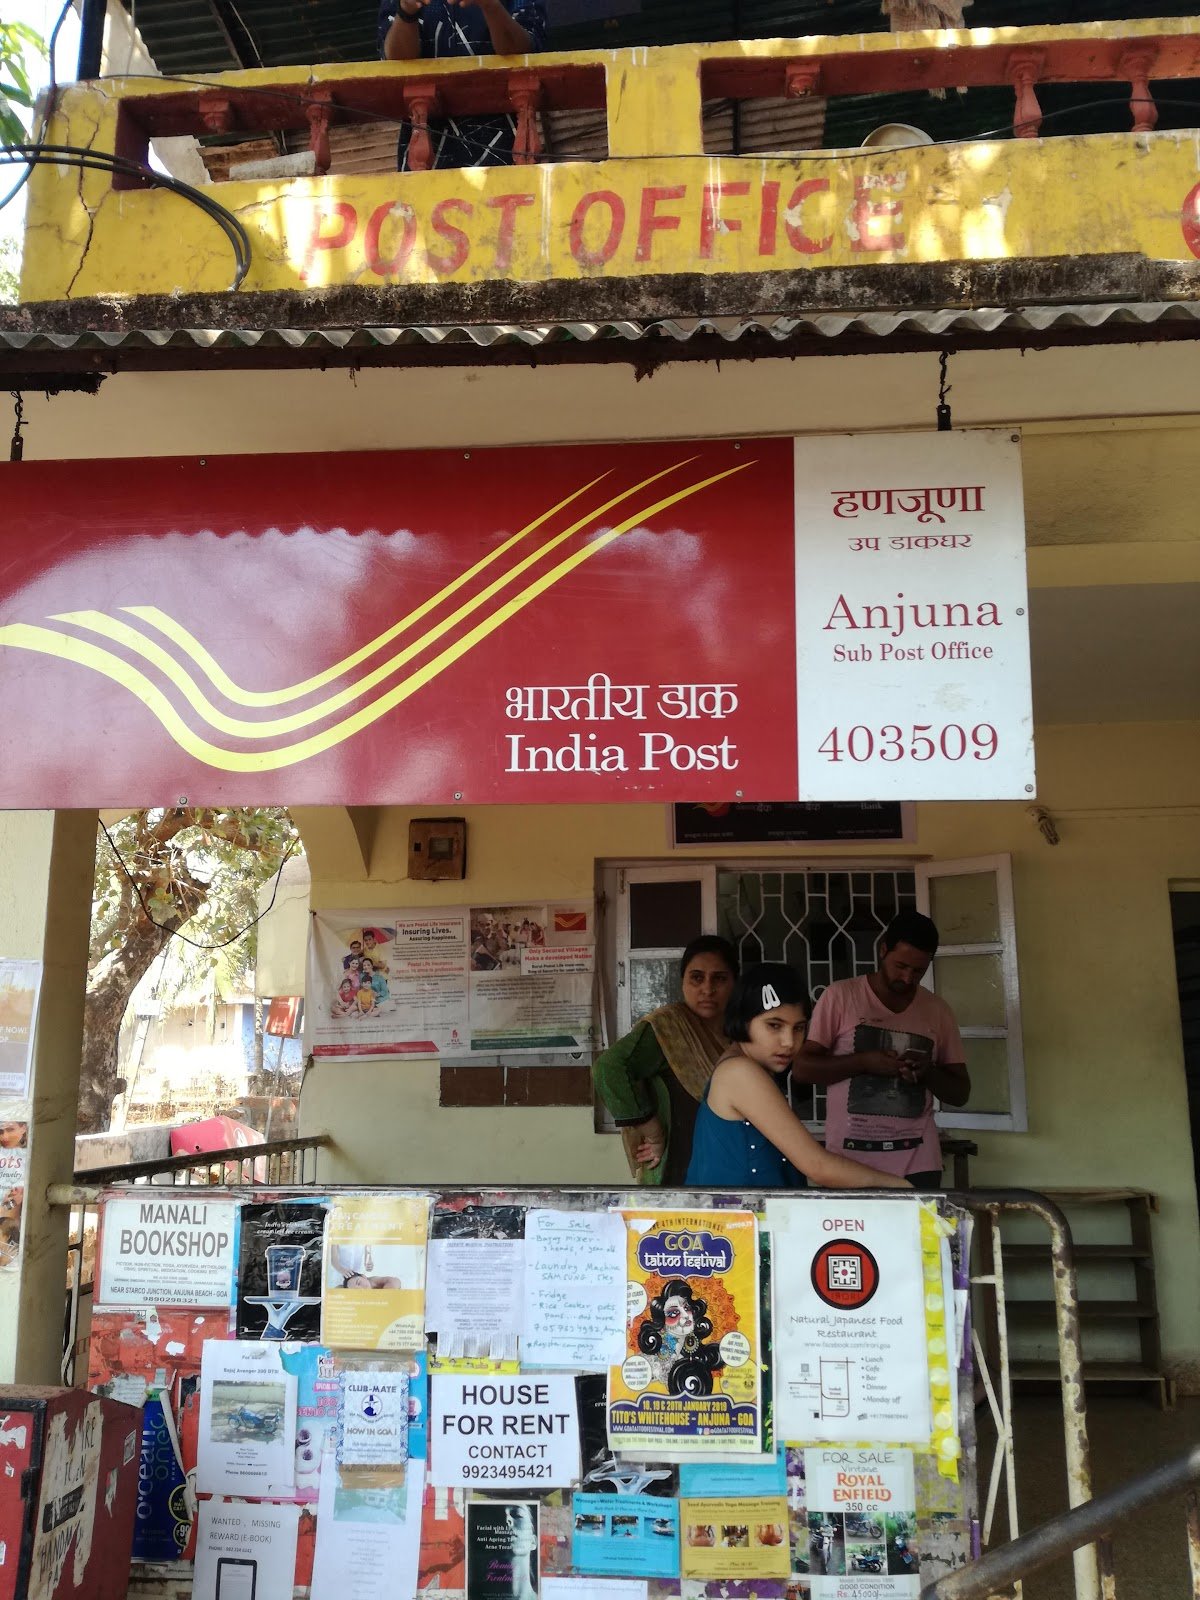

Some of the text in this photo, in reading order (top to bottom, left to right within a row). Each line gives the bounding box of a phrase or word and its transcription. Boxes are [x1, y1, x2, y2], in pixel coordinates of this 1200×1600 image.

[300, 175, 906, 280] POST OFFICE
[831, 486, 986, 523] हणजूणा
[848, 534, 973, 551] उप डाकघर
[822, 592, 1003, 637] Anjuna
[833, 641, 993, 662] Sub Post Office
[505, 673, 739, 721] भारतीय डाक
[818, 723, 998, 762] 403509
[505, 732, 739, 772] India Post
[402, 928, 430, 936] Insuring
[140, 1204, 207, 1225] MANALI
[536, 1215, 555, 1228] For
[675, 1218, 724, 1233] INTERNATIONAL
[822, 1219, 865, 1232] OPEN
[120, 1229, 229, 1257] BOOKSHOP
[566, 1235, 593, 1243] mixer
[665, 1234, 705, 1251] GOA
[535, 1258, 577, 1274] Laundry
[644, 1250, 727, 1270] tattoo festival
[539, 1289, 568, 1302] Fridge
[790, 1315, 903, 1327] Natural Japanese Food
[817, 1330, 877, 1338] Restaurant
[348, 1385, 397, 1393] CLUB-MATE
[462, 1384, 549, 1405] HOUSE
[667, 1401, 682, 1410] 20TH
[683, 1401, 711, 1411] JANUARY
[712, 1402, 727, 1411] 2019
[866, 1396, 890, 1405] Monday
[442, 1414, 570, 1435] FOR RENT
[612, 1411, 754, 1427] TITO'S WHITEHOUSE ANJUNA GOA
[346, 1427, 365, 1435] NOW
[468, 1445, 548, 1459] CONTACT
[823, 1452, 896, 1464] FOR SALE
[462, 1464, 553, 1478] 9923495421
[841, 1465, 878, 1473] Vintage
[837, 1472, 885, 1488] ROYAL
[833, 1488, 892, 1502] ENFIELD
[846, 1502, 863, 1511] 350
[211, 1516, 281, 1528] WANTED MISSING
[209, 1532, 272, 1543] REWARD (E-BOOK)
